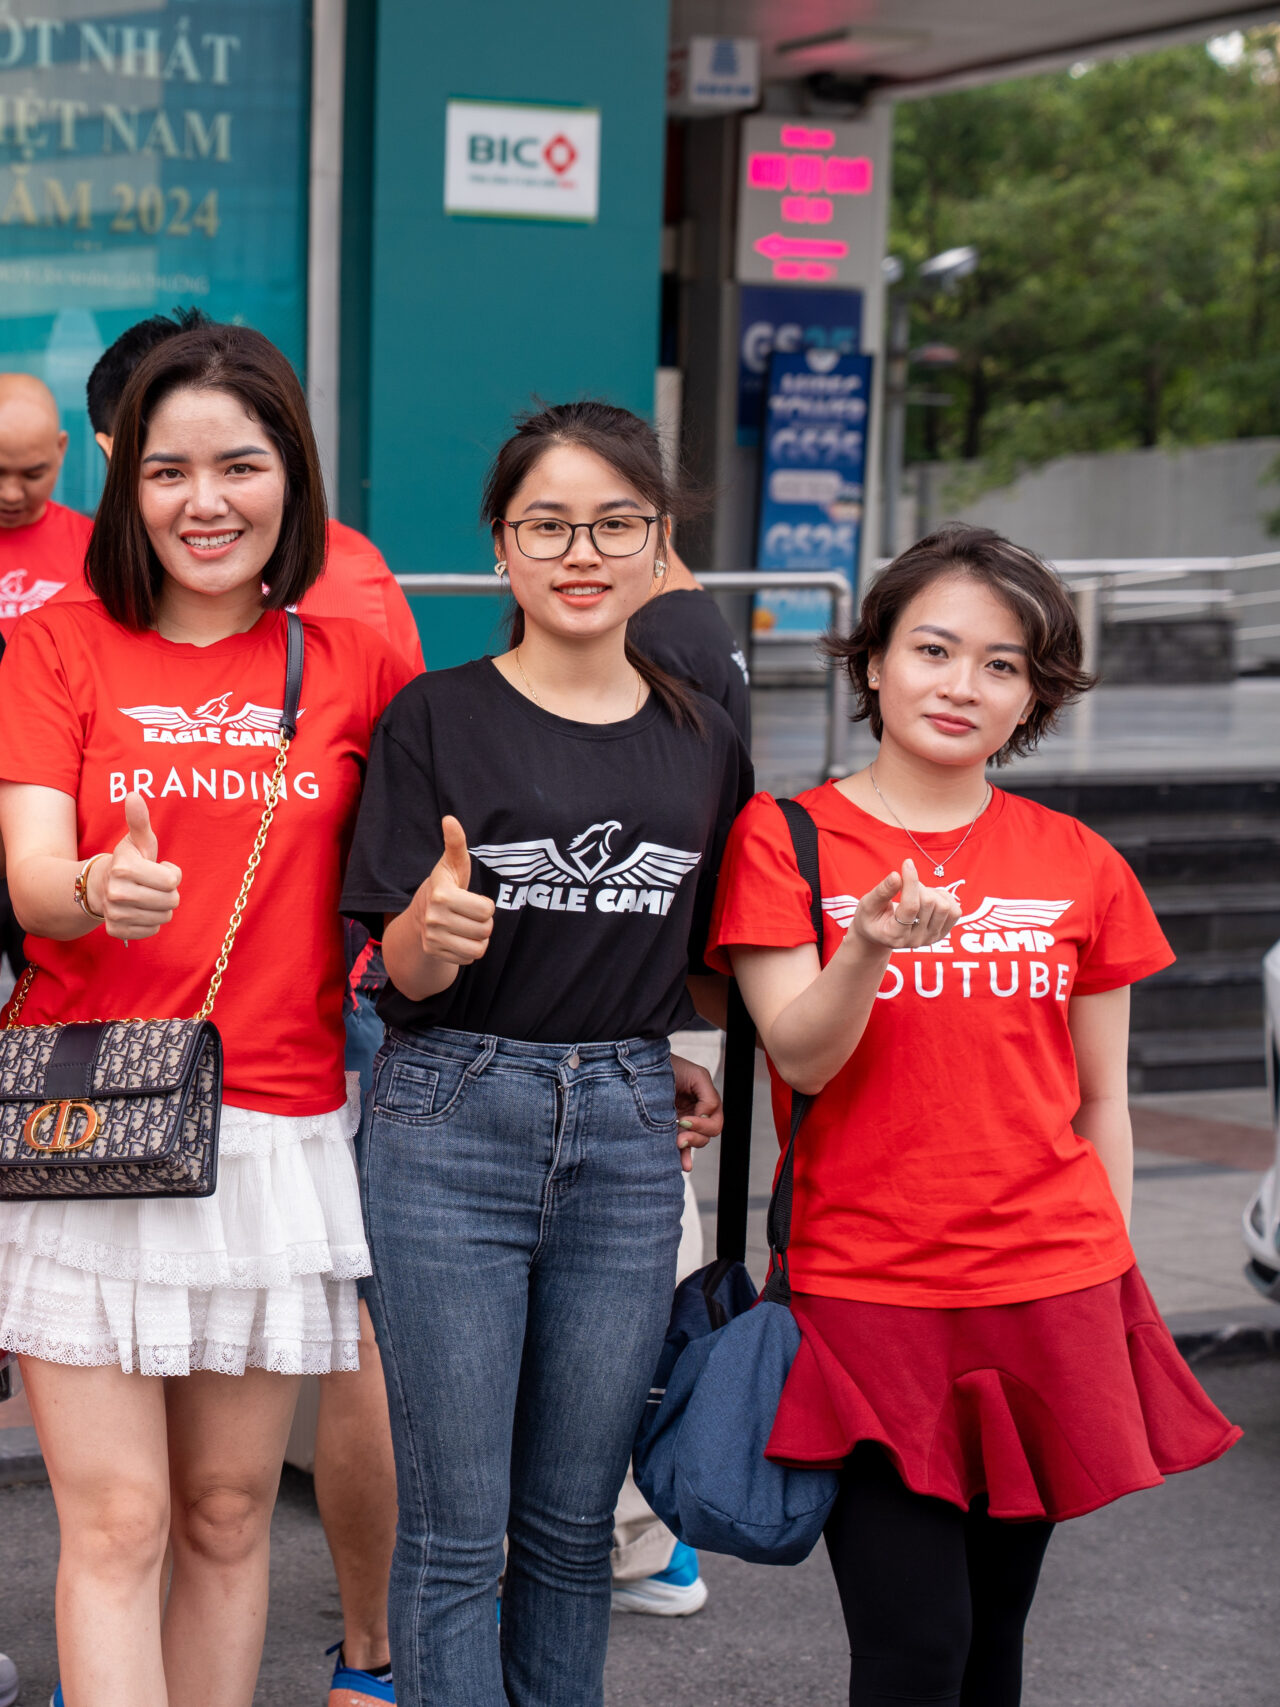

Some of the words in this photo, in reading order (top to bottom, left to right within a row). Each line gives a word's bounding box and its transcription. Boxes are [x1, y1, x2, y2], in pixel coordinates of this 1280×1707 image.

[101, 103, 232, 162] NAM
[109, 183, 220, 238] 2024
[143, 728, 220, 744] EAGLE
[110, 766, 319, 803] BRANDING
[496, 883, 589, 913] EAGLE
[960, 929, 1055, 954] CAMP
